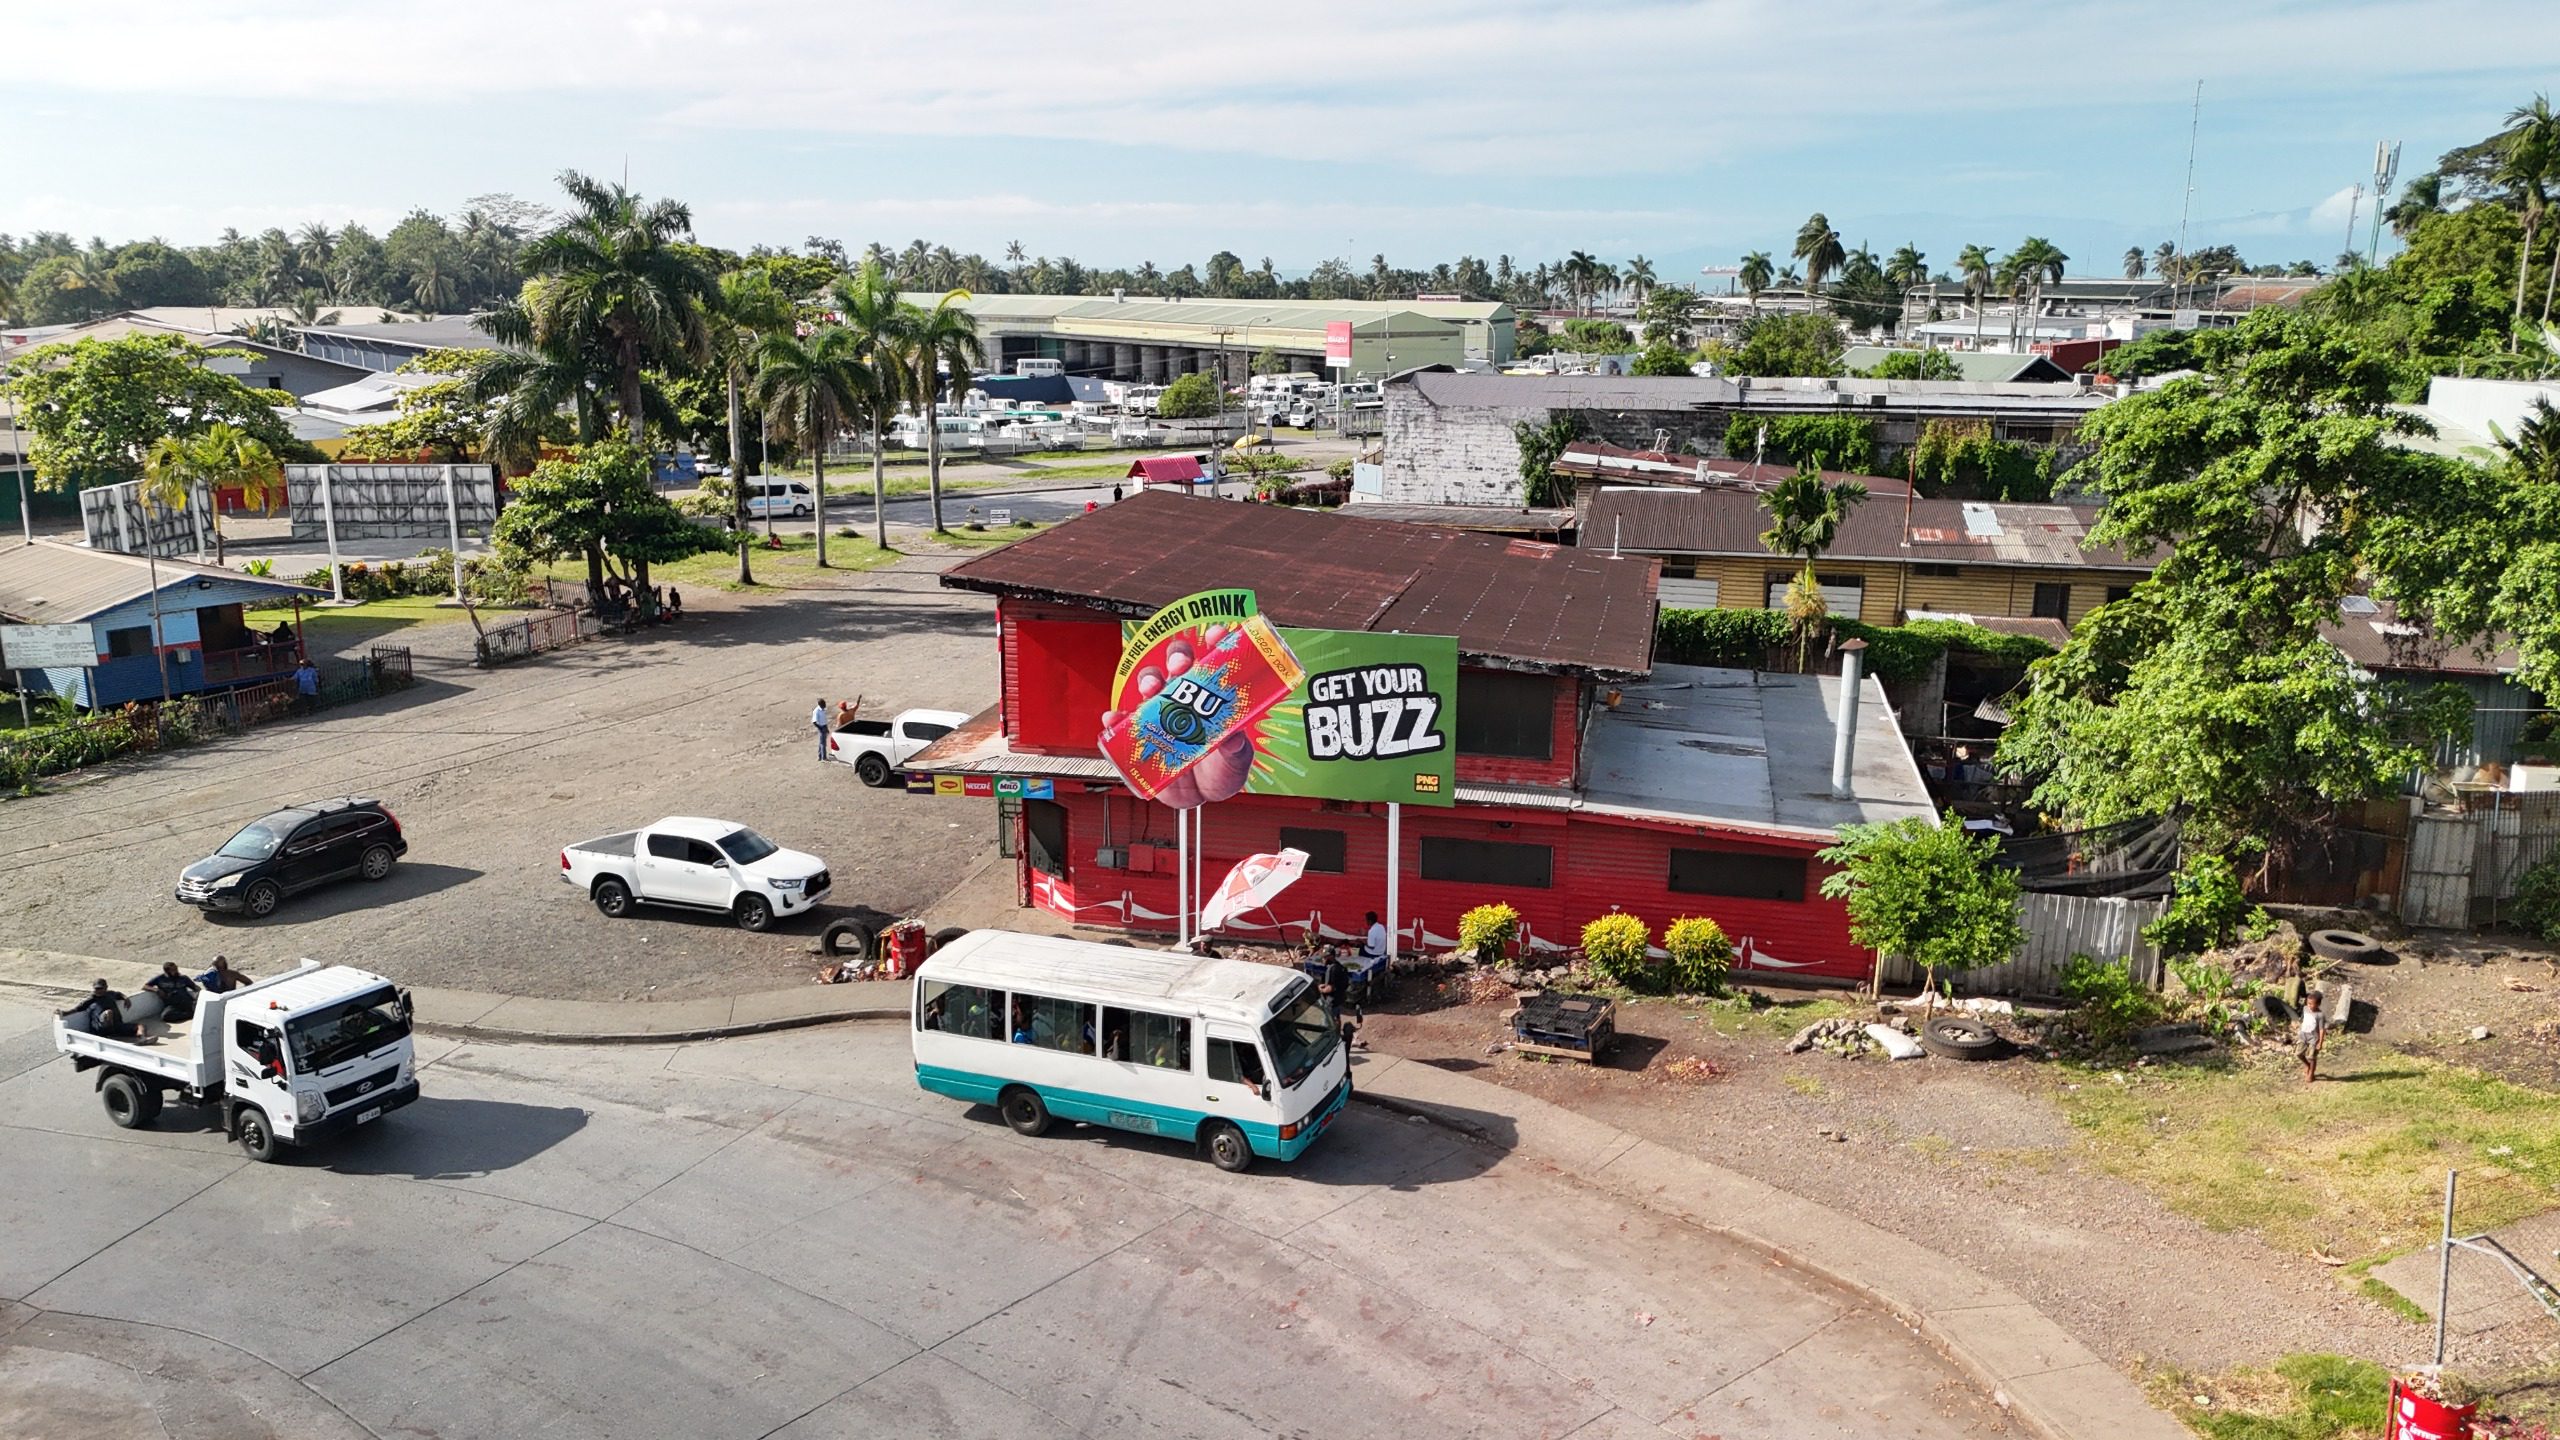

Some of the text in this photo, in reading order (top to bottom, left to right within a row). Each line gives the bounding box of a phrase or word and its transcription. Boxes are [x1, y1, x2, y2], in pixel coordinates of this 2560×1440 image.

[1119, 594, 1247, 677] HIGH FUEL ENERGY DRINK
[1171, 680, 1222, 716] BU
[1313, 668, 1423, 701] GET YOUR
[1308, 697, 1440, 757] BUZZ
[1416, 775, 1439, 785] PNG
